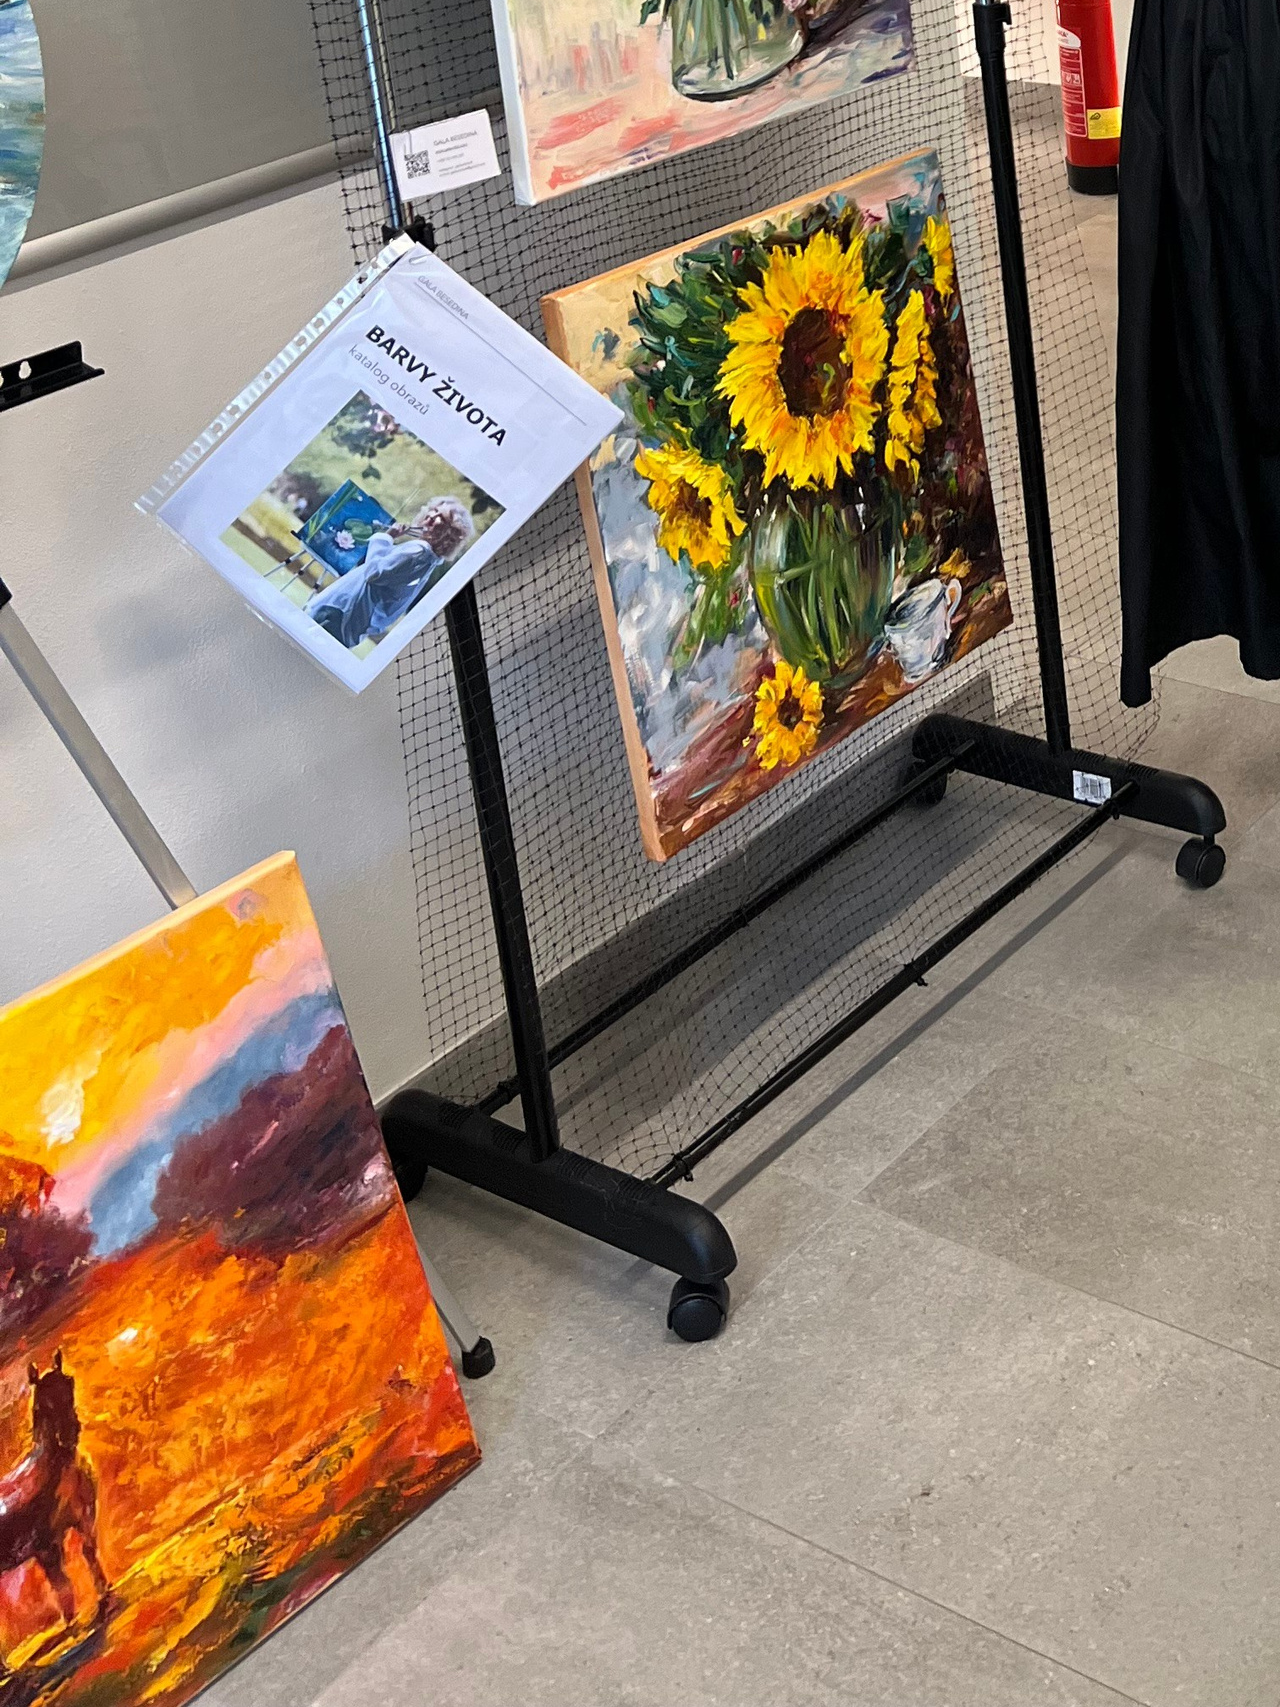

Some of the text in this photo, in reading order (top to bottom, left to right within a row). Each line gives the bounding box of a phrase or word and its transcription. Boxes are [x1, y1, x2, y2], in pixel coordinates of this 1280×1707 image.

[418, 275, 469, 320] GALA BESEDINA
[348, 344, 430, 415] katalog obrazů
[365, 324, 507, 446] BARVY ŽIVOTA
